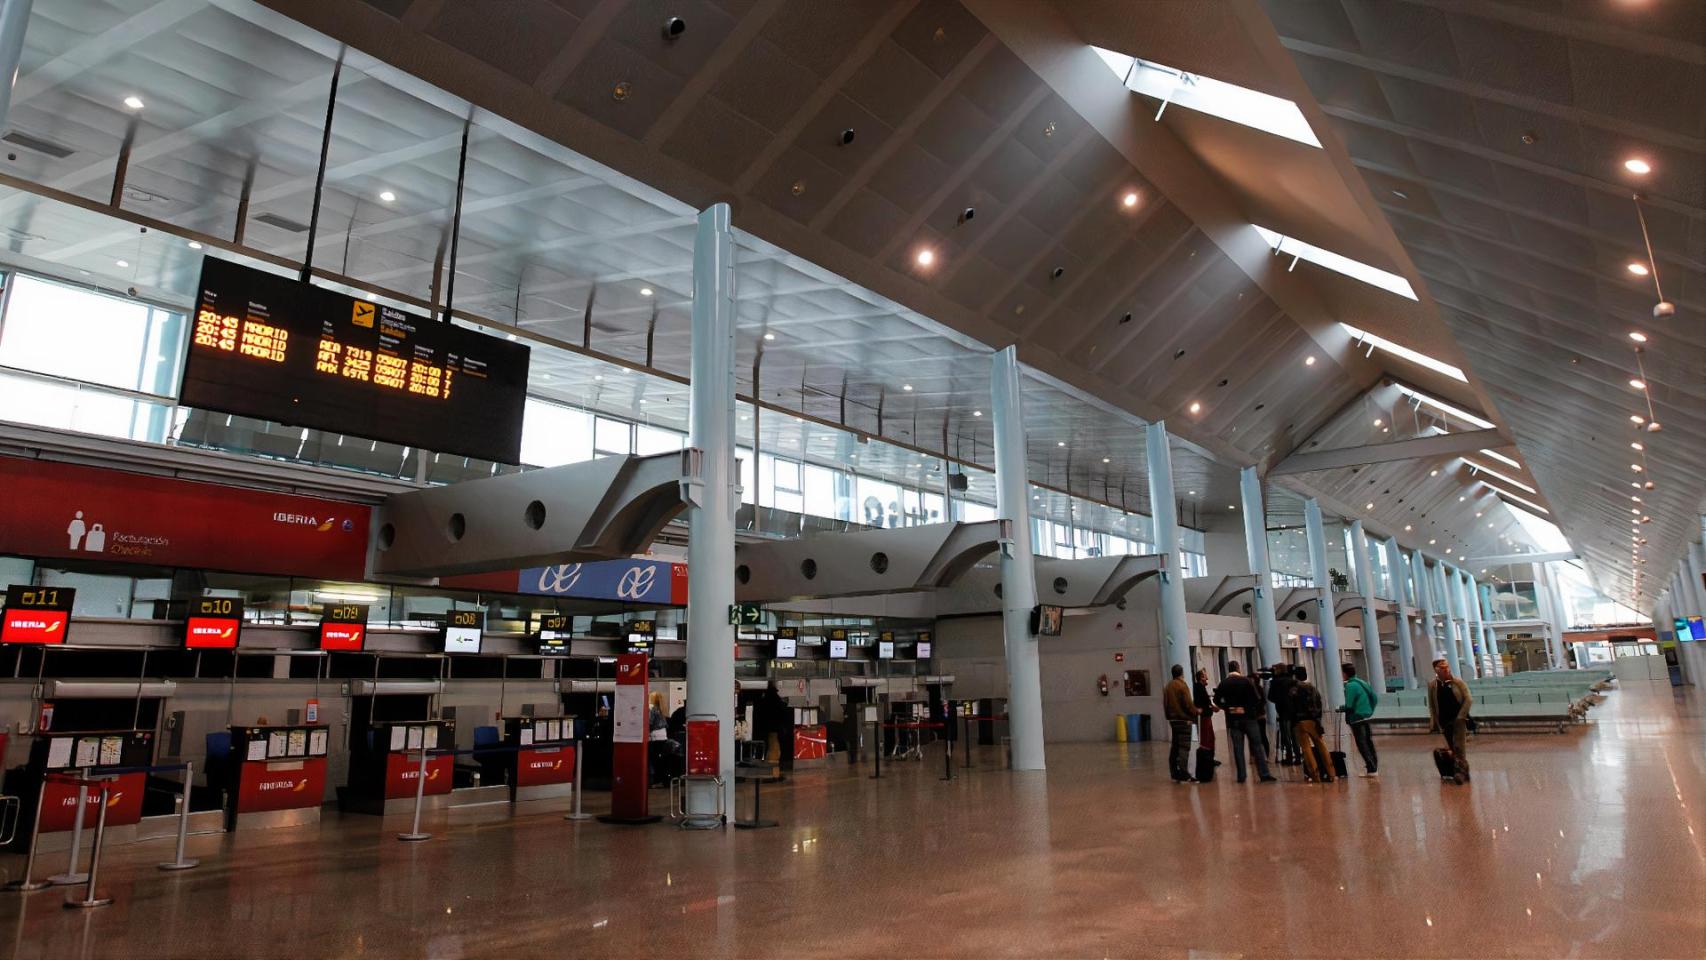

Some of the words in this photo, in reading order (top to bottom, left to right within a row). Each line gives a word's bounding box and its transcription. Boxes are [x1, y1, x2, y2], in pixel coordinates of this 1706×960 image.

[199, 310, 239, 329] 20:45
[244, 320, 288, 341] MADRID
[197, 321, 238, 340] 20:45
[242, 331, 287, 352] MADRID
[195, 332, 235, 351] 20:45
[240, 342, 285, 362] MADRID
[273, 512, 318, 526] IBERIA
[36, 589, 58, 605] 11
[213, 600, 232, 614] 10
[11, 621, 46, 629] IBERIA
[193, 627, 222, 635] IBERIA
